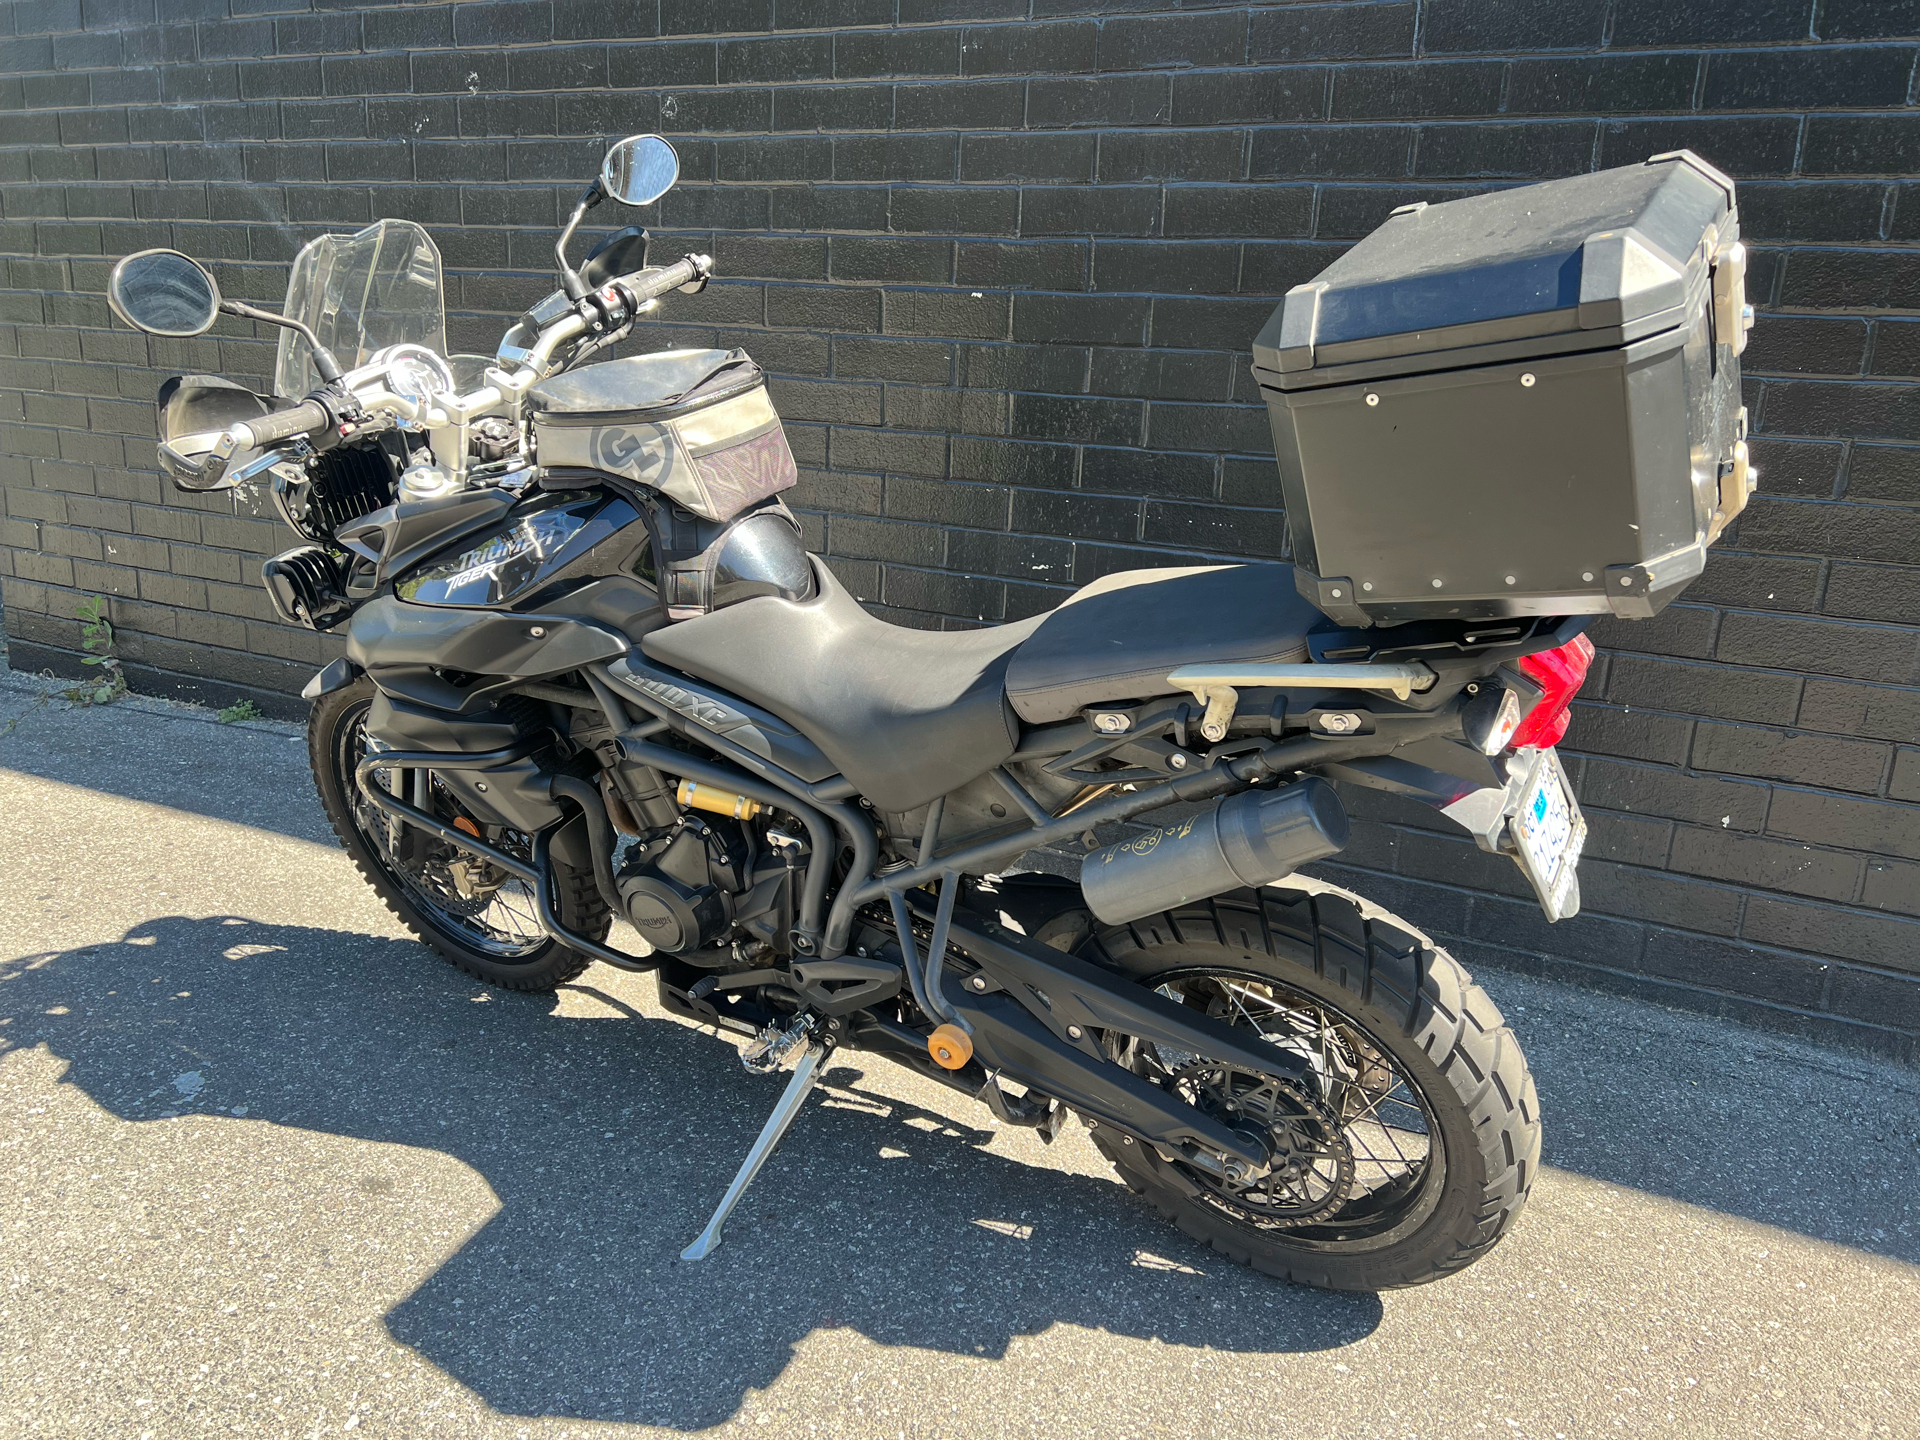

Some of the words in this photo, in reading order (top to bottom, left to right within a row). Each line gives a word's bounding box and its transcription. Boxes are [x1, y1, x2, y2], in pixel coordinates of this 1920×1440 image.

[458, 529, 555, 571] TRIUMPH
[444, 560, 499, 600] TIGER
[635, 915, 672, 928] TRIUMPH
